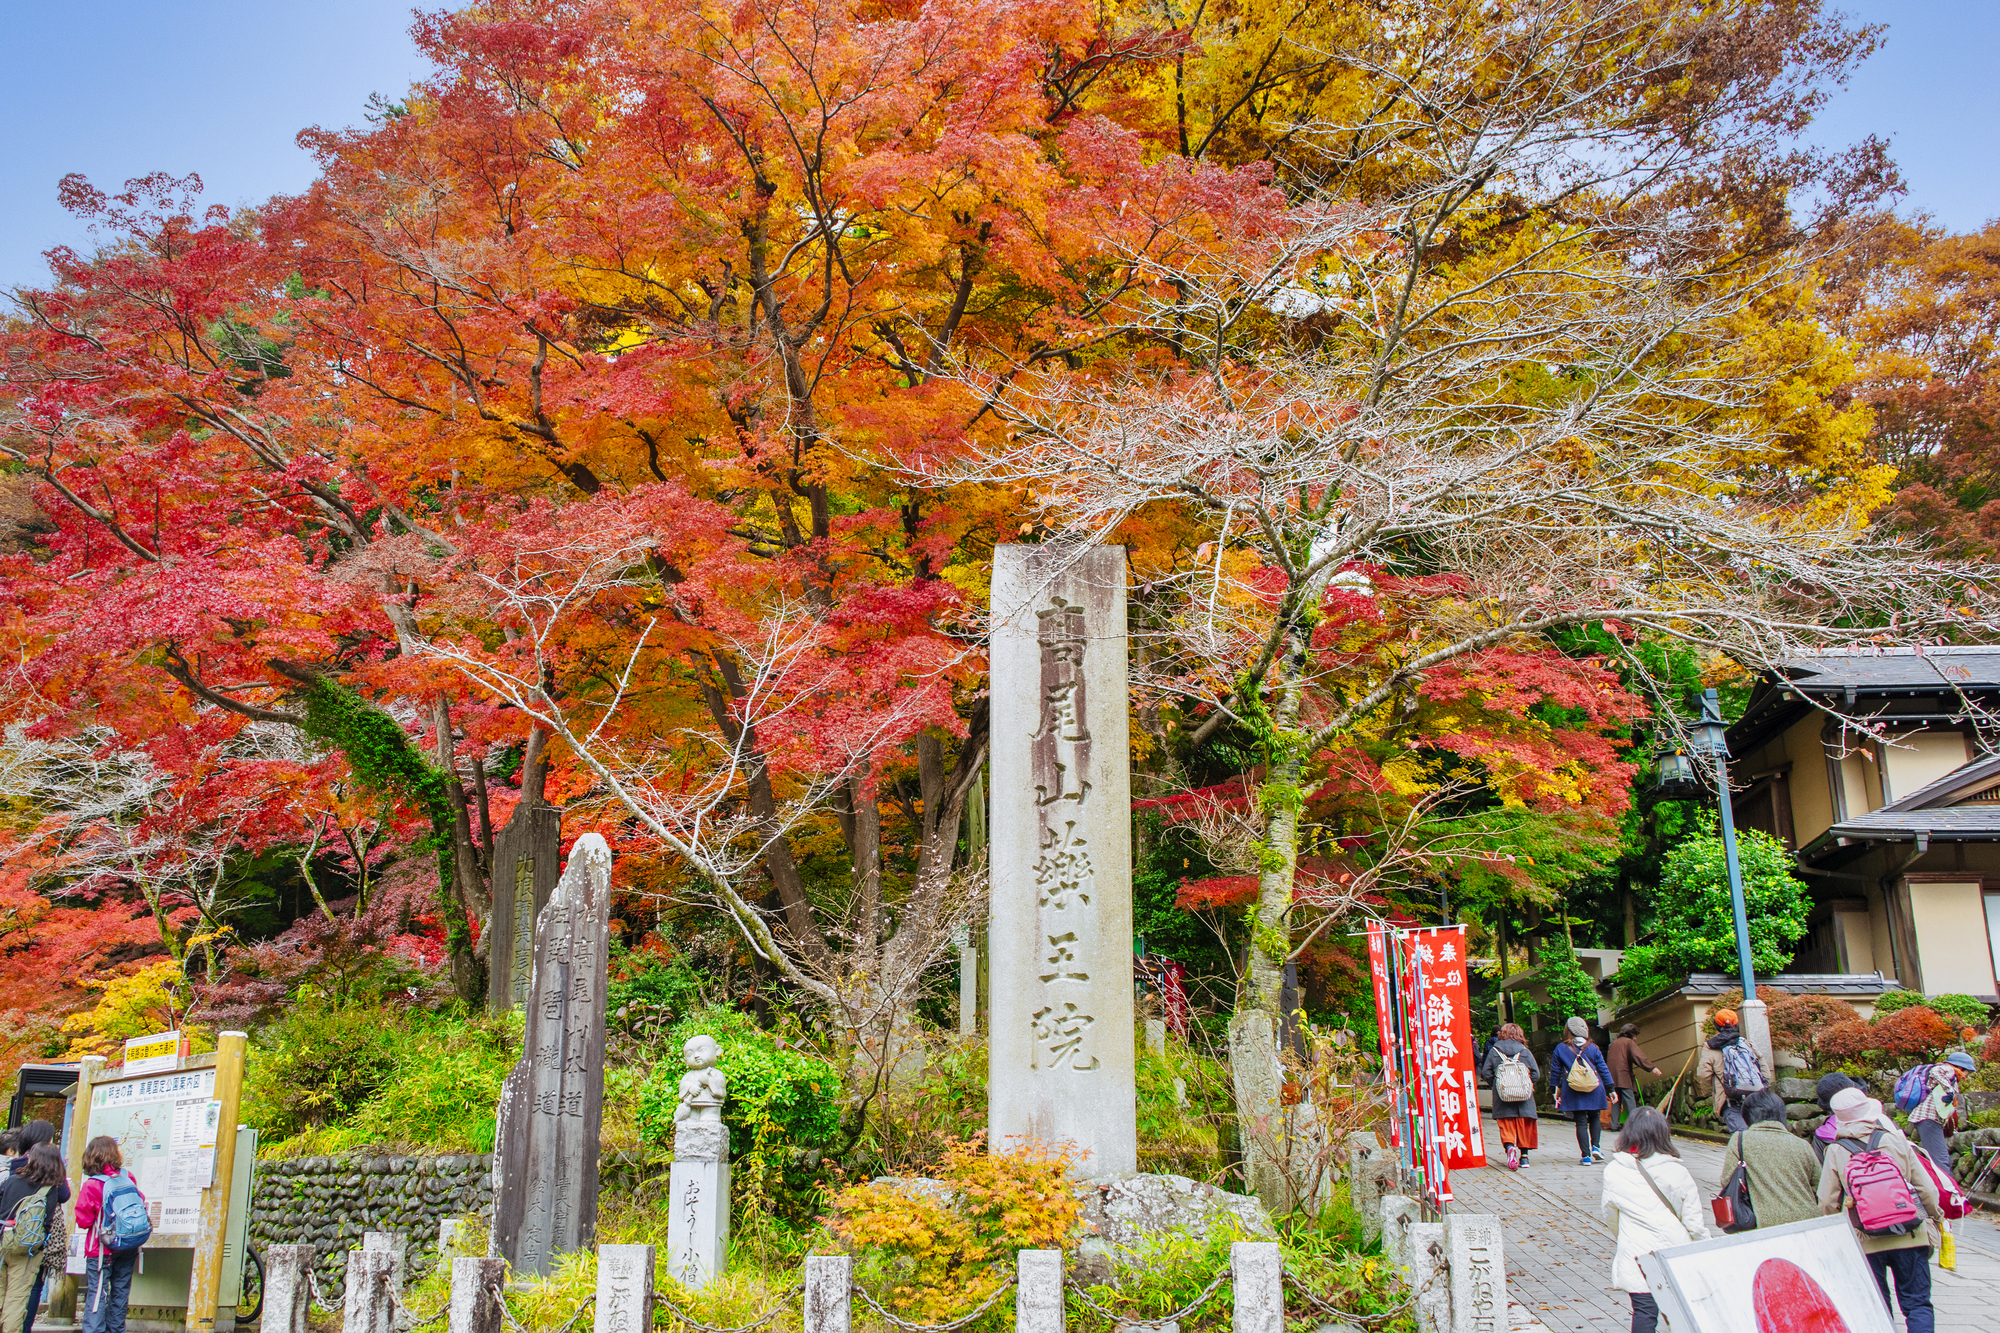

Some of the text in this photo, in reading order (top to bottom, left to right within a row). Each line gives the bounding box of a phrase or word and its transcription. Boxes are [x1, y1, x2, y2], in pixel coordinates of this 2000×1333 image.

[679, 1179, 701, 1284] おそうじ小僧
[1463, 1227, 1492, 1245] 奉納
[608, 1276, 632, 1333] こがね
